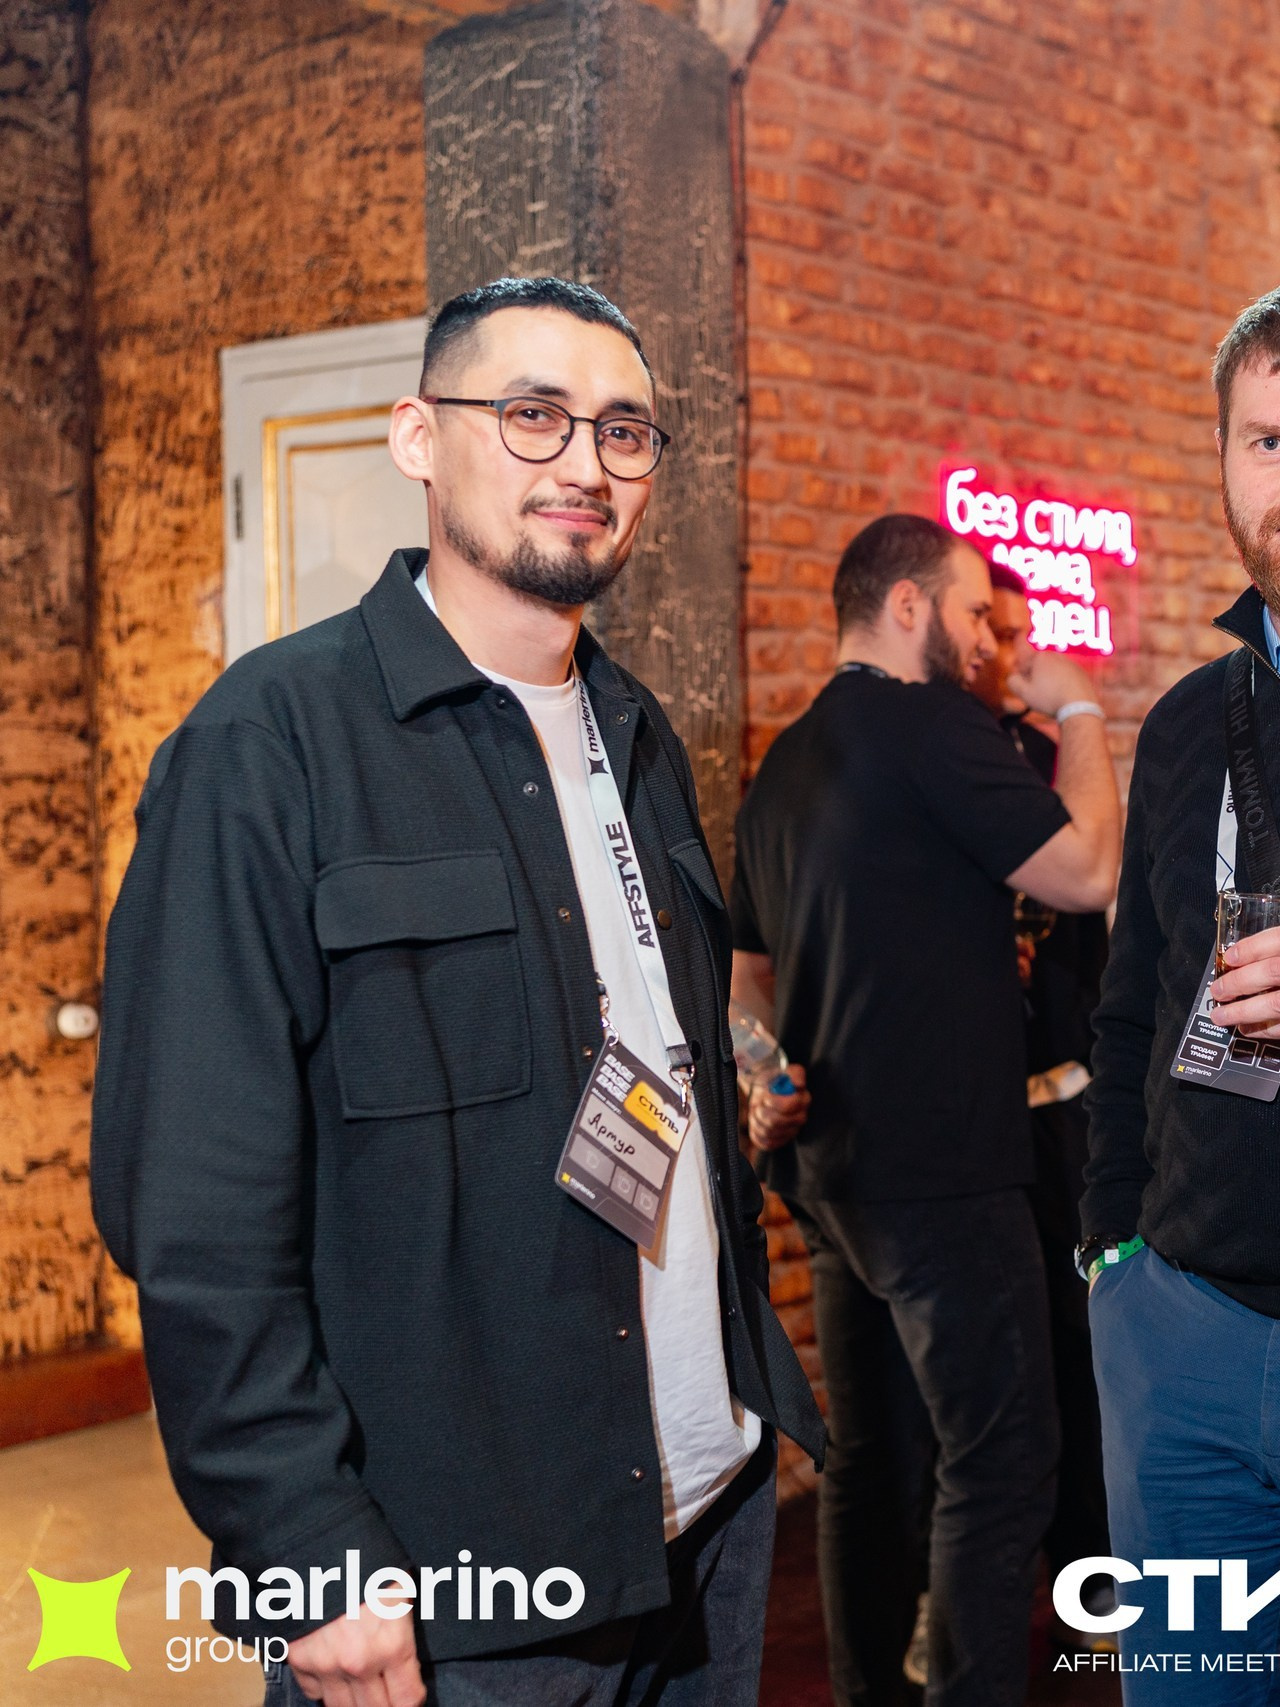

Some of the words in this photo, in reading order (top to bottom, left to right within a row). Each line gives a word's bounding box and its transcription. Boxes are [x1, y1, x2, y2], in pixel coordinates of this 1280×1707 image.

[945, 467, 1019, 540] без
[579, 680, 600, 752] marlerino
[605, 821, 656, 949] AFFSTYLE
[1197, 1020, 1229, 1034] ПОКУПАЮ
[1199, 1027, 1224, 1039] ТРАФИК
[1190, 1044, 1218, 1056] ПРОДАЮ
[1190, 1051, 1214, 1062] ТРАФИК
[600, 1065, 632, 1092] BASE
[604, 1053, 636, 1081] BASE
[1185, 1065, 1212, 1077] marlerino
[596, 1075, 628, 1102] BASE
[638, 1094, 680, 1134] СТИЛЬ
[588, 1112, 636, 1156] Артур
